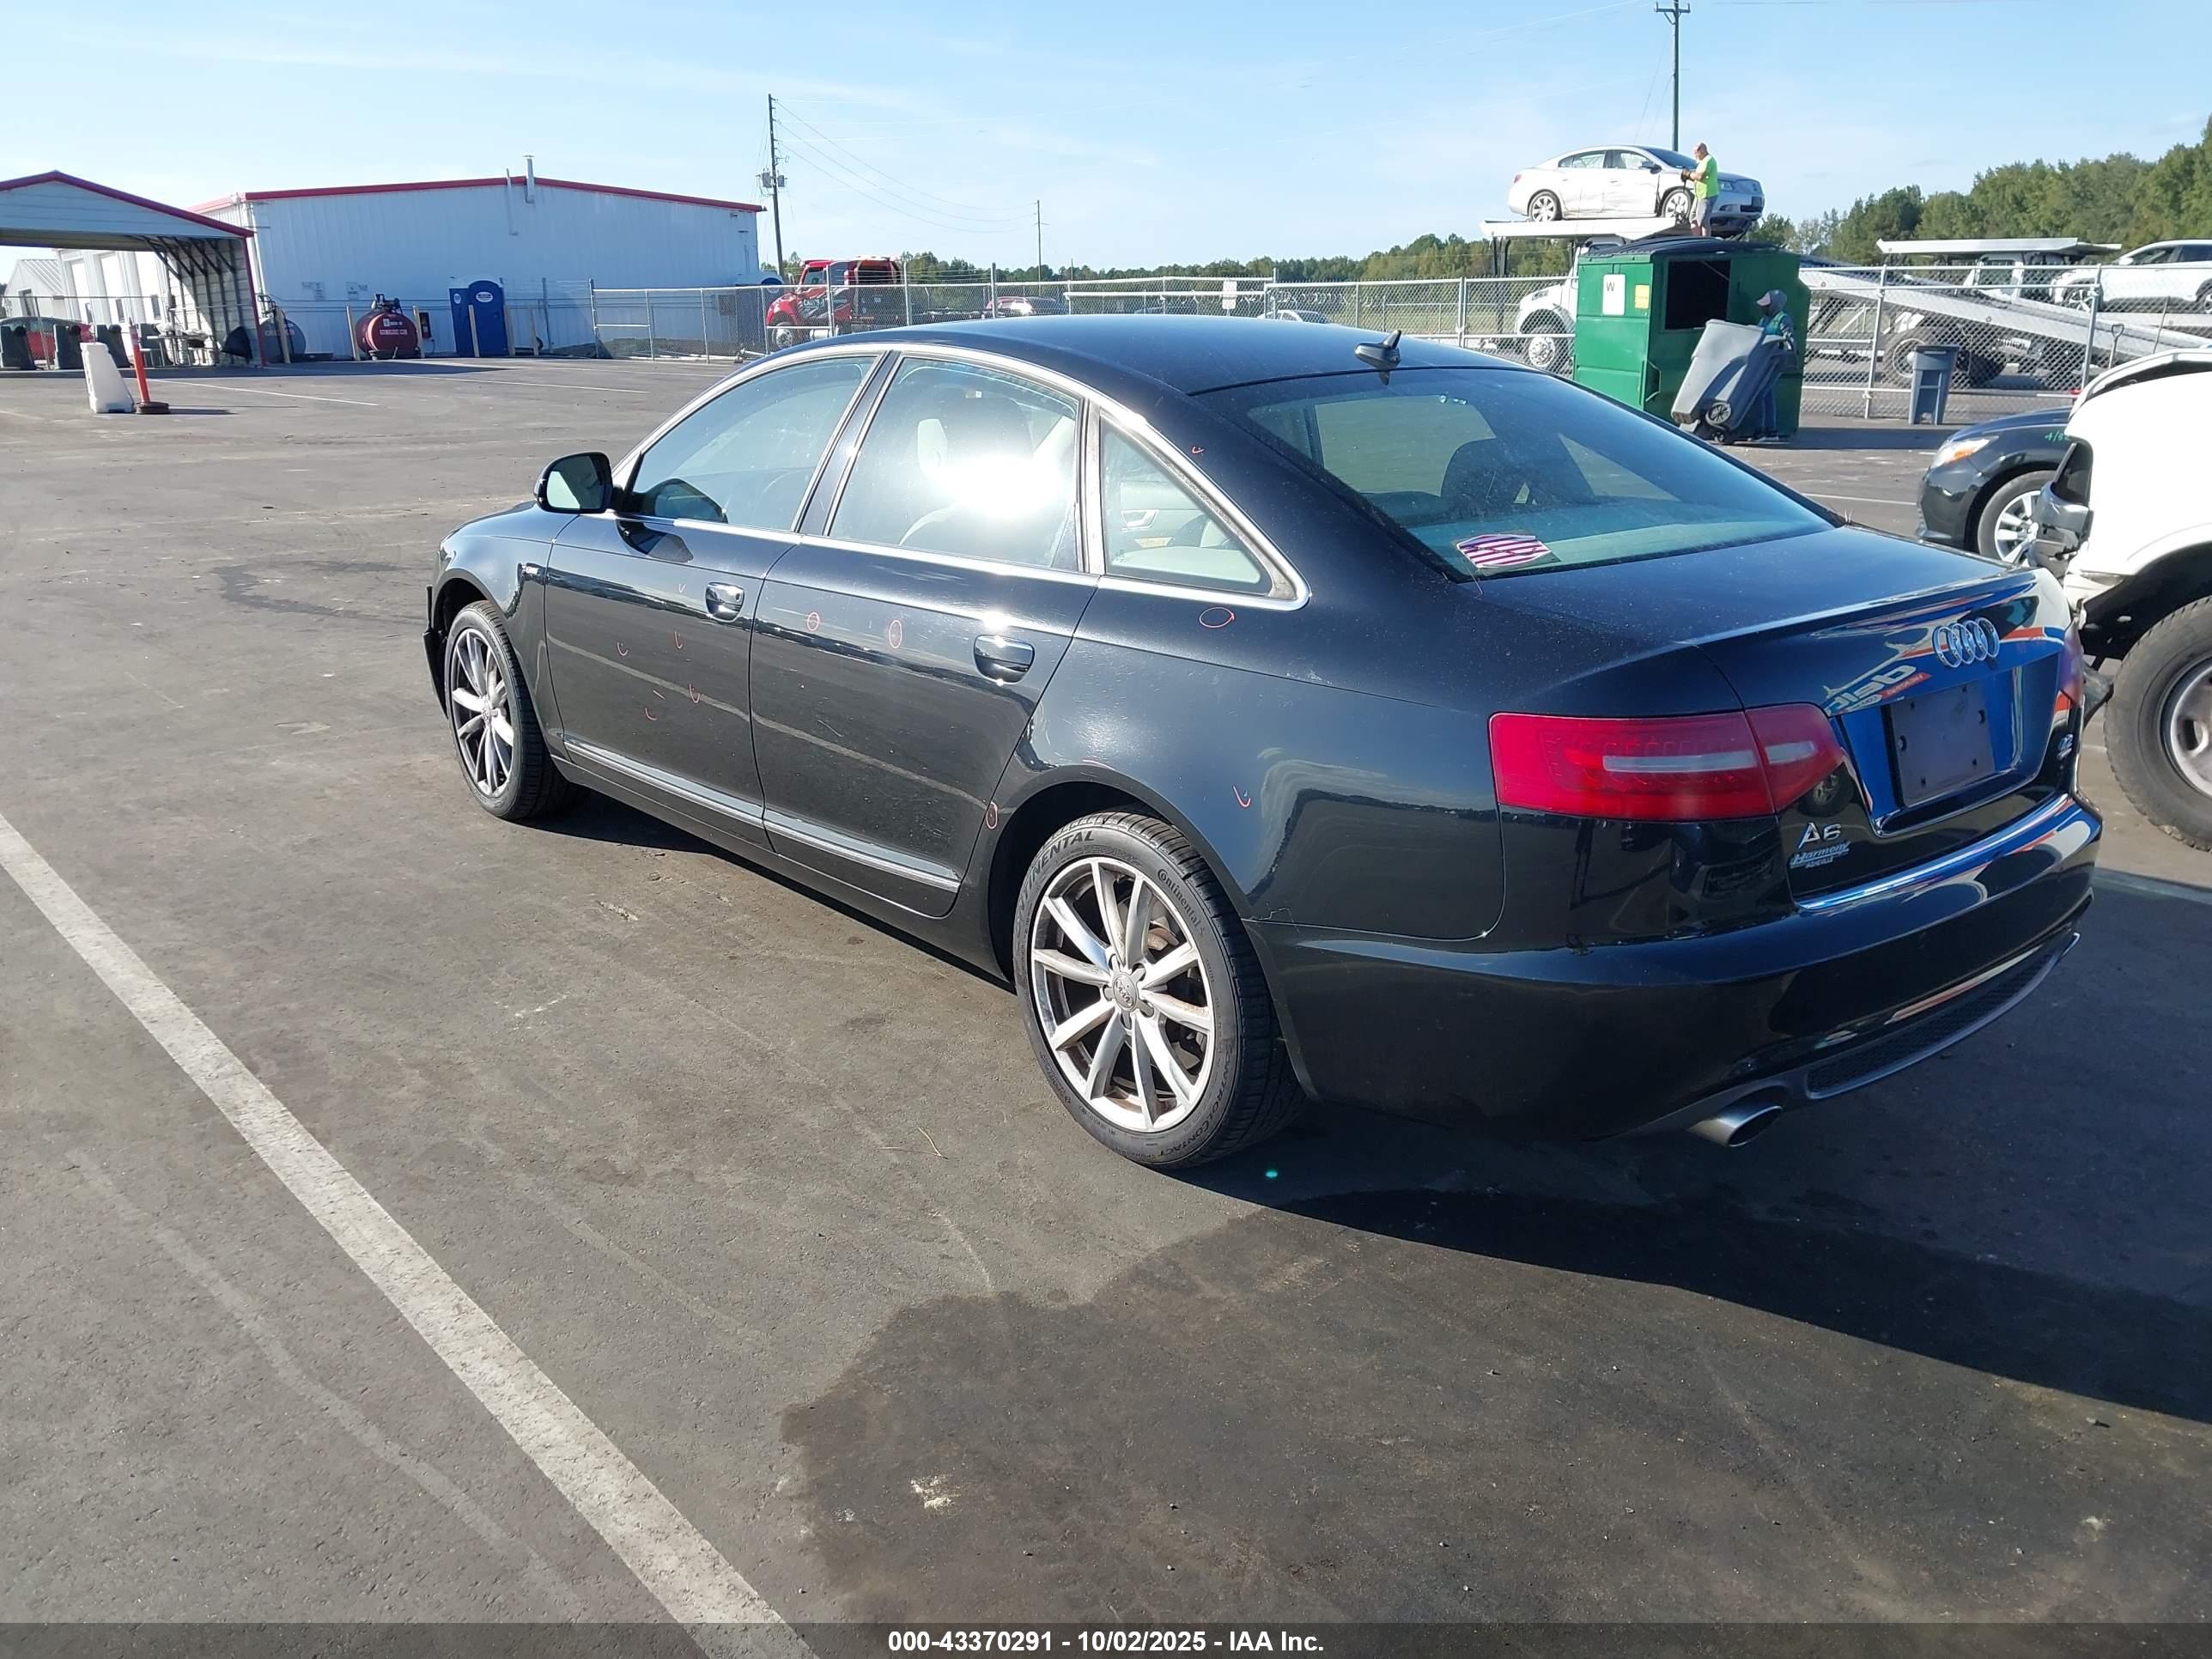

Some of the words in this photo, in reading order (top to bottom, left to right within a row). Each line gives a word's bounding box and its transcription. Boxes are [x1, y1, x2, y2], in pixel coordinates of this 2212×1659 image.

[1607, 282, 1614, 291] W
[1798, 822, 1841, 849] A6
[1158, 868, 1201, 927] Continental
